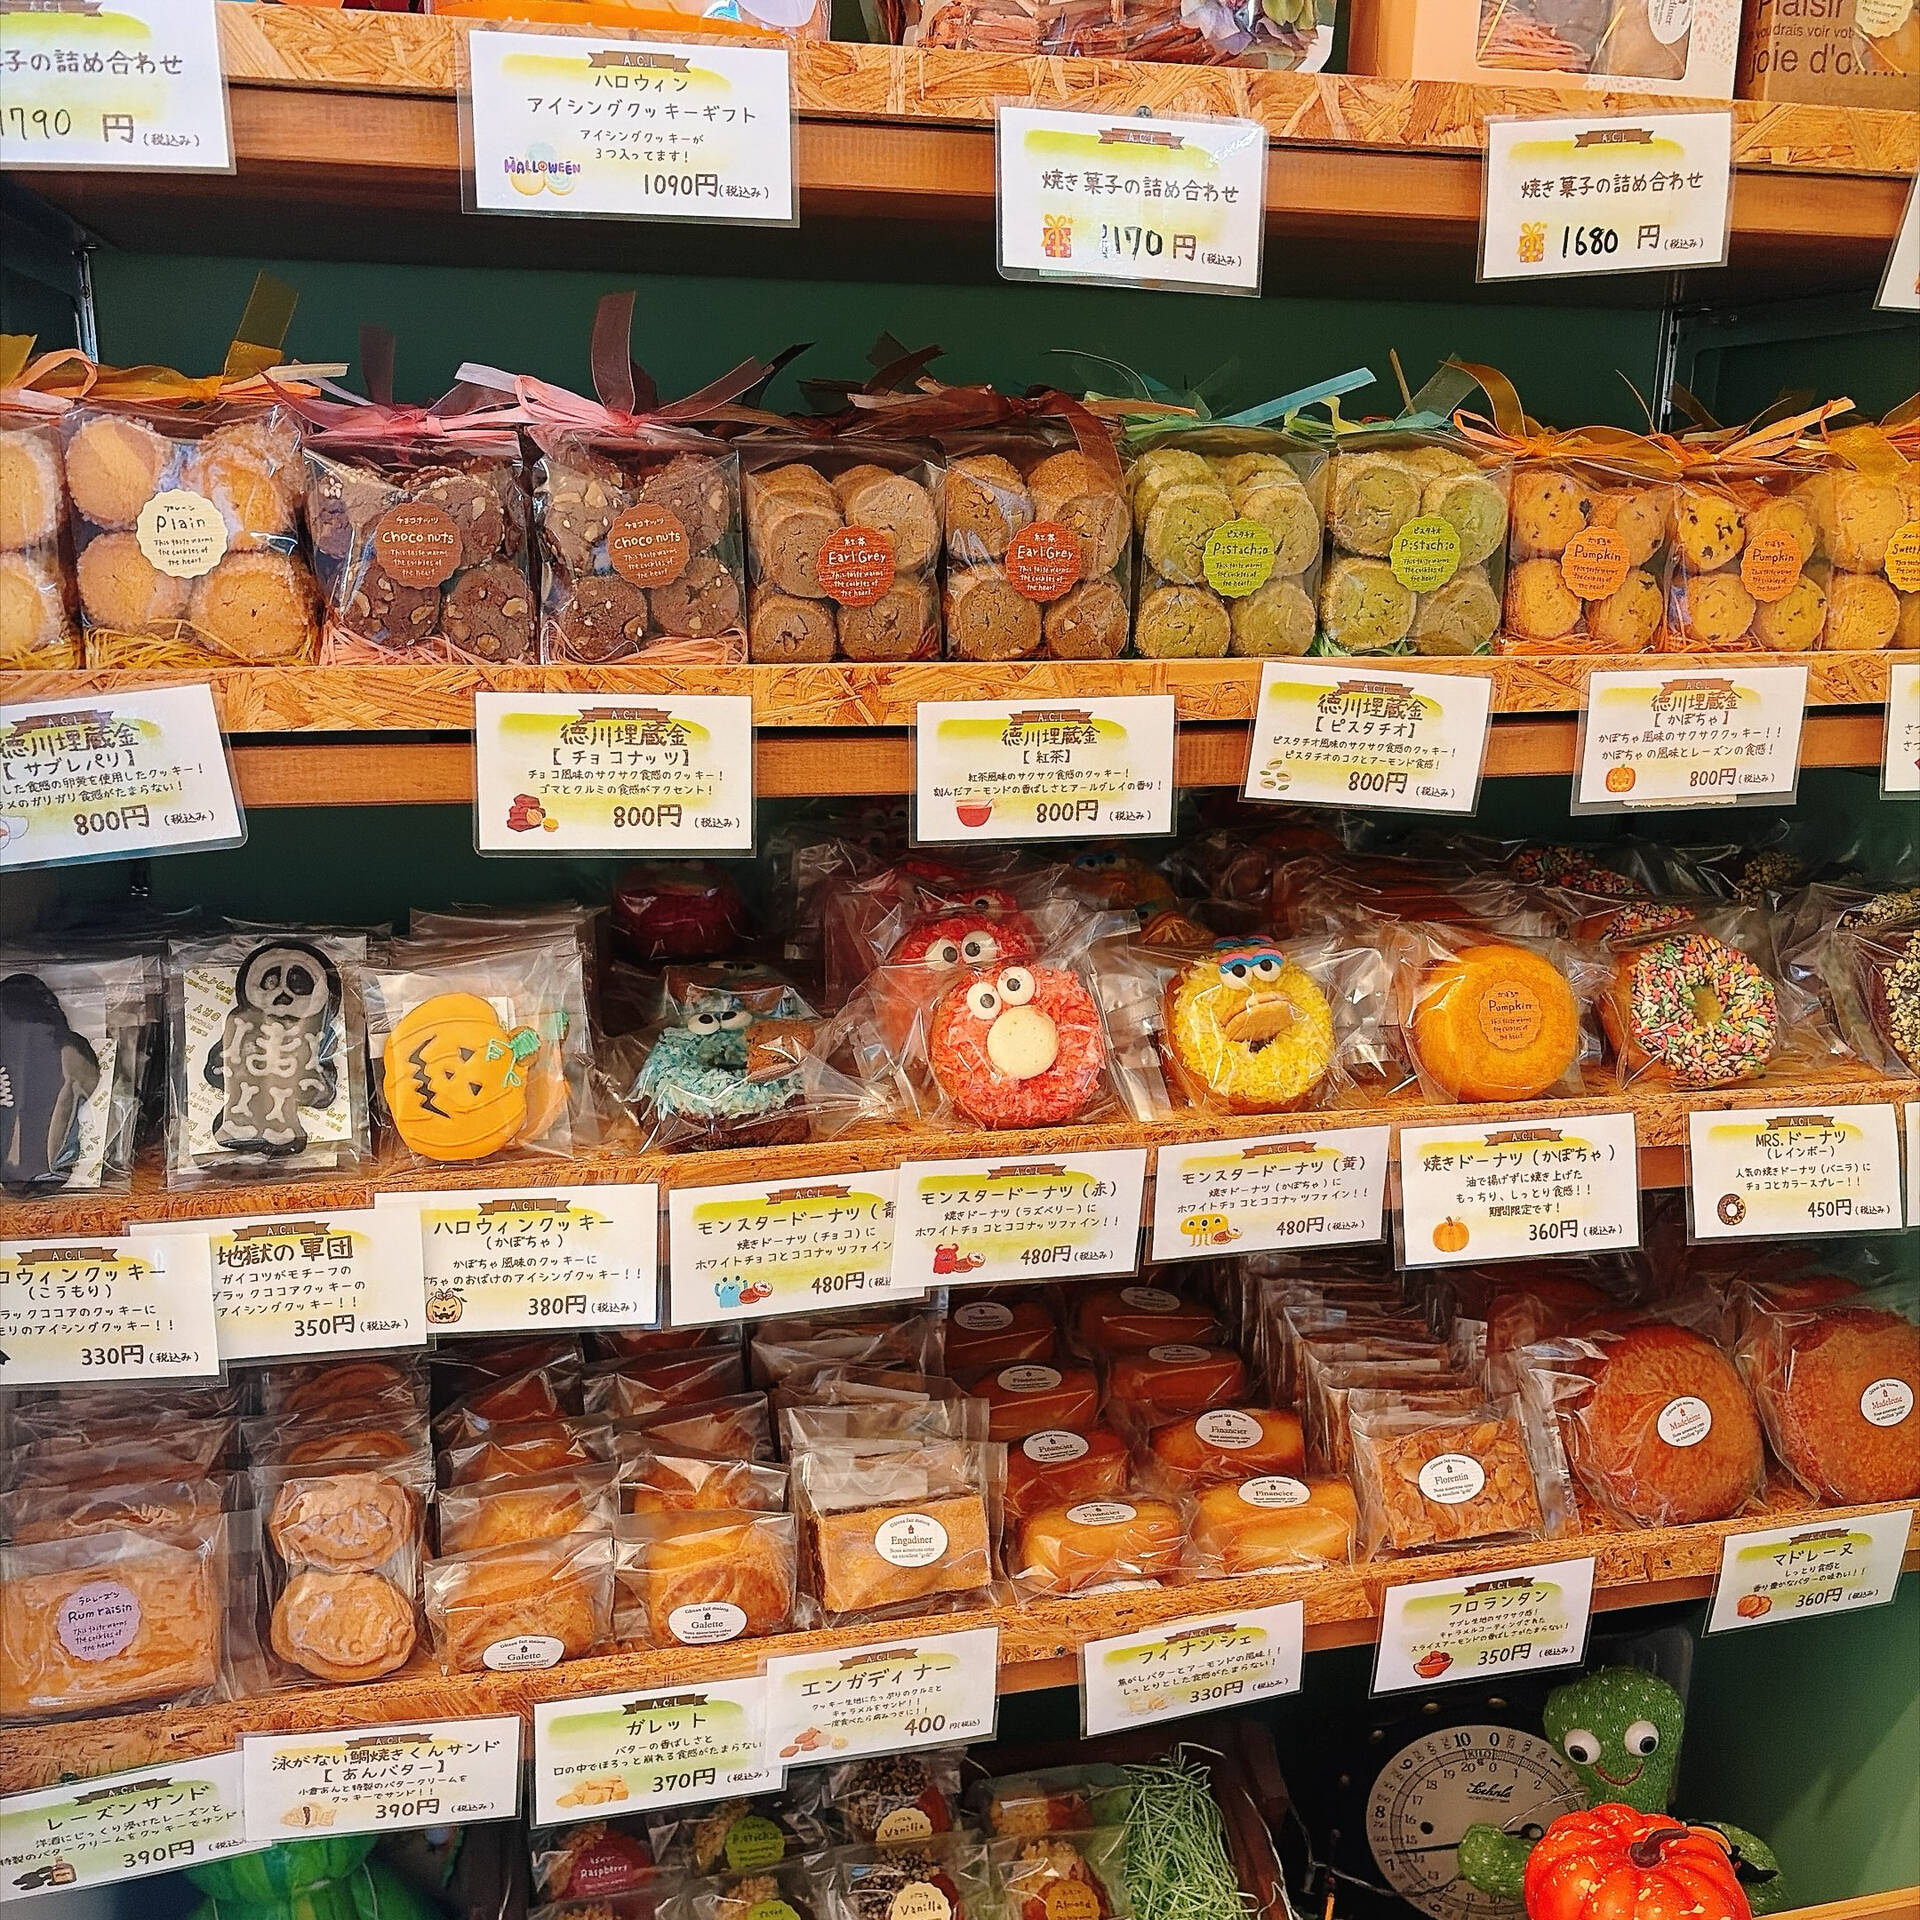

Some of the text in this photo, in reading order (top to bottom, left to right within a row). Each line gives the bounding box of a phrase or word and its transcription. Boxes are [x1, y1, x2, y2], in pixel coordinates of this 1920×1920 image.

[0, 49, 183, 75] 子の詰め合わせ
[595, 74, 688, 93] ハロウィン
[527, 97, 756, 123] アイシングクッキーギフト
[102, 113, 133, 143] 円
[580, 129, 703, 144] アイシングクッキーが
[1042, 169, 1239, 203] 焼き菓子の詰め合わせ
[1521, 171, 1703, 199] 焼き菓子の詰め合わせ
[1562, 226, 1618, 258] 1680
[1637, 224, 1660, 250] 円
[157, 515, 205, 533] Plain
[382, 531, 454, 544] Choco nuts
[656, 531, 680, 542] nuts
[1400, 539, 1454, 552] Pistachio
[829, 550, 886, 565] Earl Grey
[1018, 545, 1073, 560] Earl Grey
[1213, 542, 1268, 555] Pistachio
[1574, 544, 1620, 562] Pumpkin
[1753, 549, 1794, 564] Pumpkin
[1318, 694, 1427, 720] 徳川埋蔵金
[1651, 691, 1742, 712] 徳川埋蔵金
[560, 722, 691, 747] 徳川埋蔵金
[1001, 726, 1100, 747] 徳川埋蔵金
[1348, 772, 1455, 798] 800円 (税込み)
[1690, 768, 1736, 787] 800円
[73, 805, 149, 835] 800円
[614, 804, 740, 829] 800円 (税込み)
[1036, 800, 1152, 823] 800円 (税込み)
[1489, 1000, 1531, 1013] Pumpkin
[1808, 1199, 1851, 1218] 450円
[434, 1214, 614, 1236] ハロウィンクッキー
[1276, 1216, 1324, 1237] 480円
[1529, 1219, 1578, 1241] 360円
[52, 1250, 84, 1261] A.C.L
[216, 1235, 353, 1267] 地獄の軍団
[1020, 1245, 1071, 1266] 480円
[221, 1266, 351, 1285] ガイコツがモチーフの
[812, 1271, 865, 1295] 480円
[528, 1295, 638, 1316] 380円 (税込み)
[294, 1314, 409, 1337] 350円 (税込み)
[82, 1345, 199, 1365] 330円 (税込み)
[1773, 1543, 1853, 1566] マドレーヌ
[1448, 1591, 1548, 1616] フロランタン
[1795, 1587, 1843, 1607] 360円
[68, 1604, 132, 1623] Rum raisin
[507, 1653, 540, 1661] Galette
[1138, 1636, 1252, 1665] フィナンシェ
[1478, 1643, 1532, 1666] 350円
[801, 1664, 951, 1697] エンガディナー
[1190, 1680, 1243, 1703] 330円
[652, 1697, 680, 1709] A.C.L
[626, 1712, 706, 1736] ガレット
[904, 1715, 945, 1737] 400
[1454, 1732, 1471, 1747] 10
[652, 1768, 716, 1793] 370円
[47, 1785, 209, 1832] レーズンサンド
[375, 1799, 439, 1819] 390円
[884, 1823, 924, 1837] Vanilla
[123, 1839, 194, 1868] 390円
[901, 1901, 942, 1915] Vanilla
